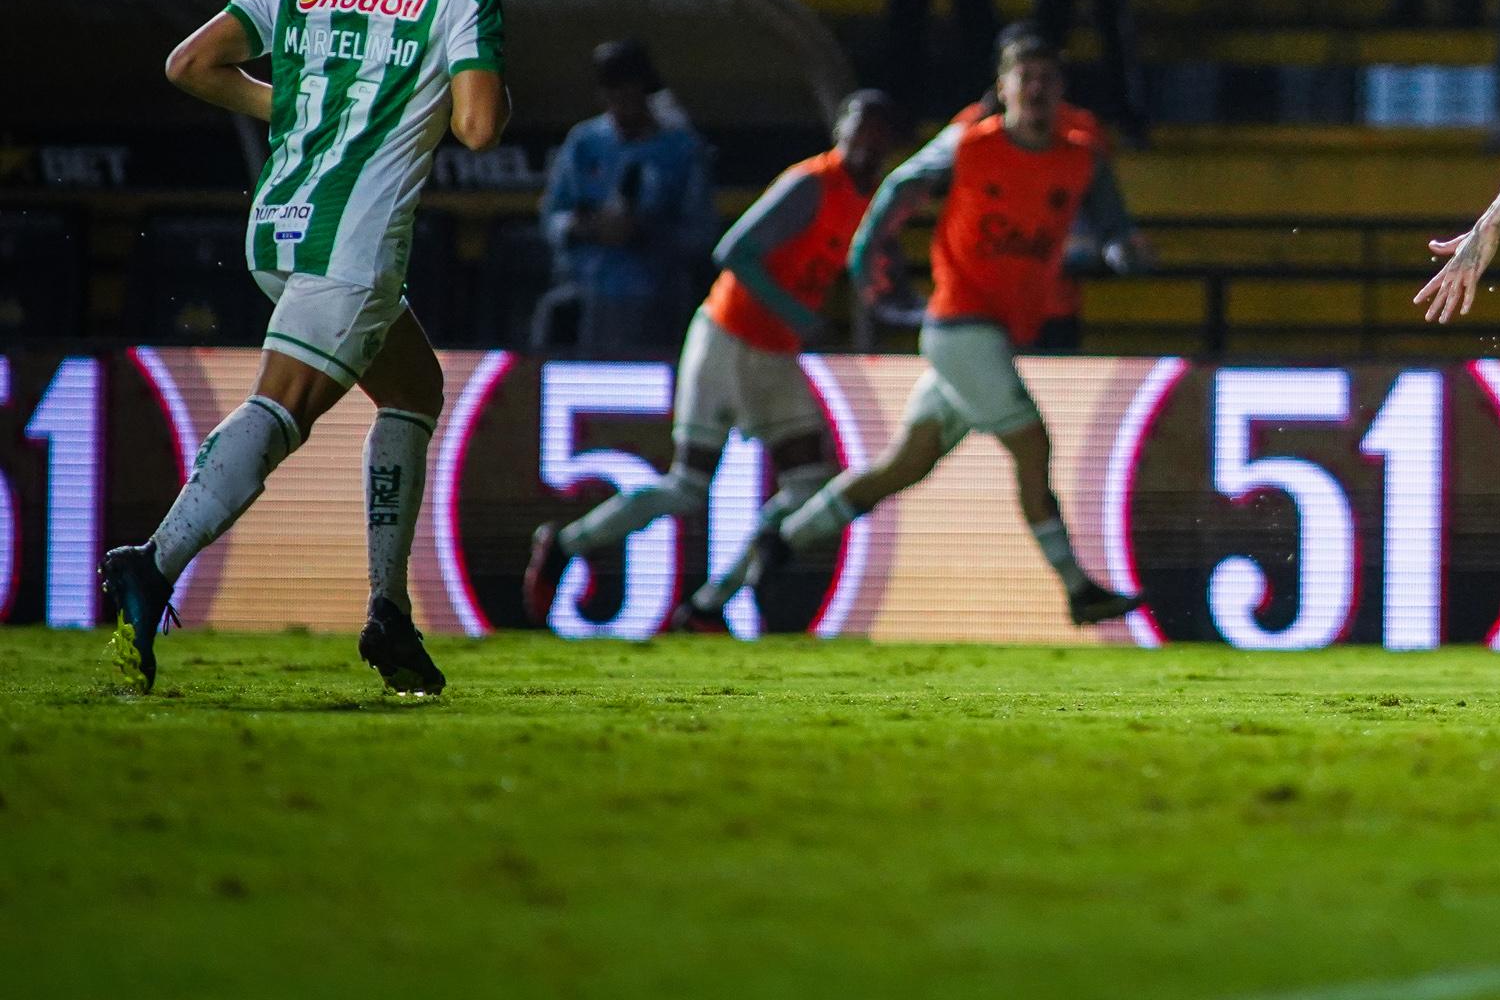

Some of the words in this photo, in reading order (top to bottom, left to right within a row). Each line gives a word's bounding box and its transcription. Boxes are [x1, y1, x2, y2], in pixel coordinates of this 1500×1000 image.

[284, 26, 419, 67] MARCELINHO
[271, 74, 380, 186] 11
[0, 356, 97, 630] 1
